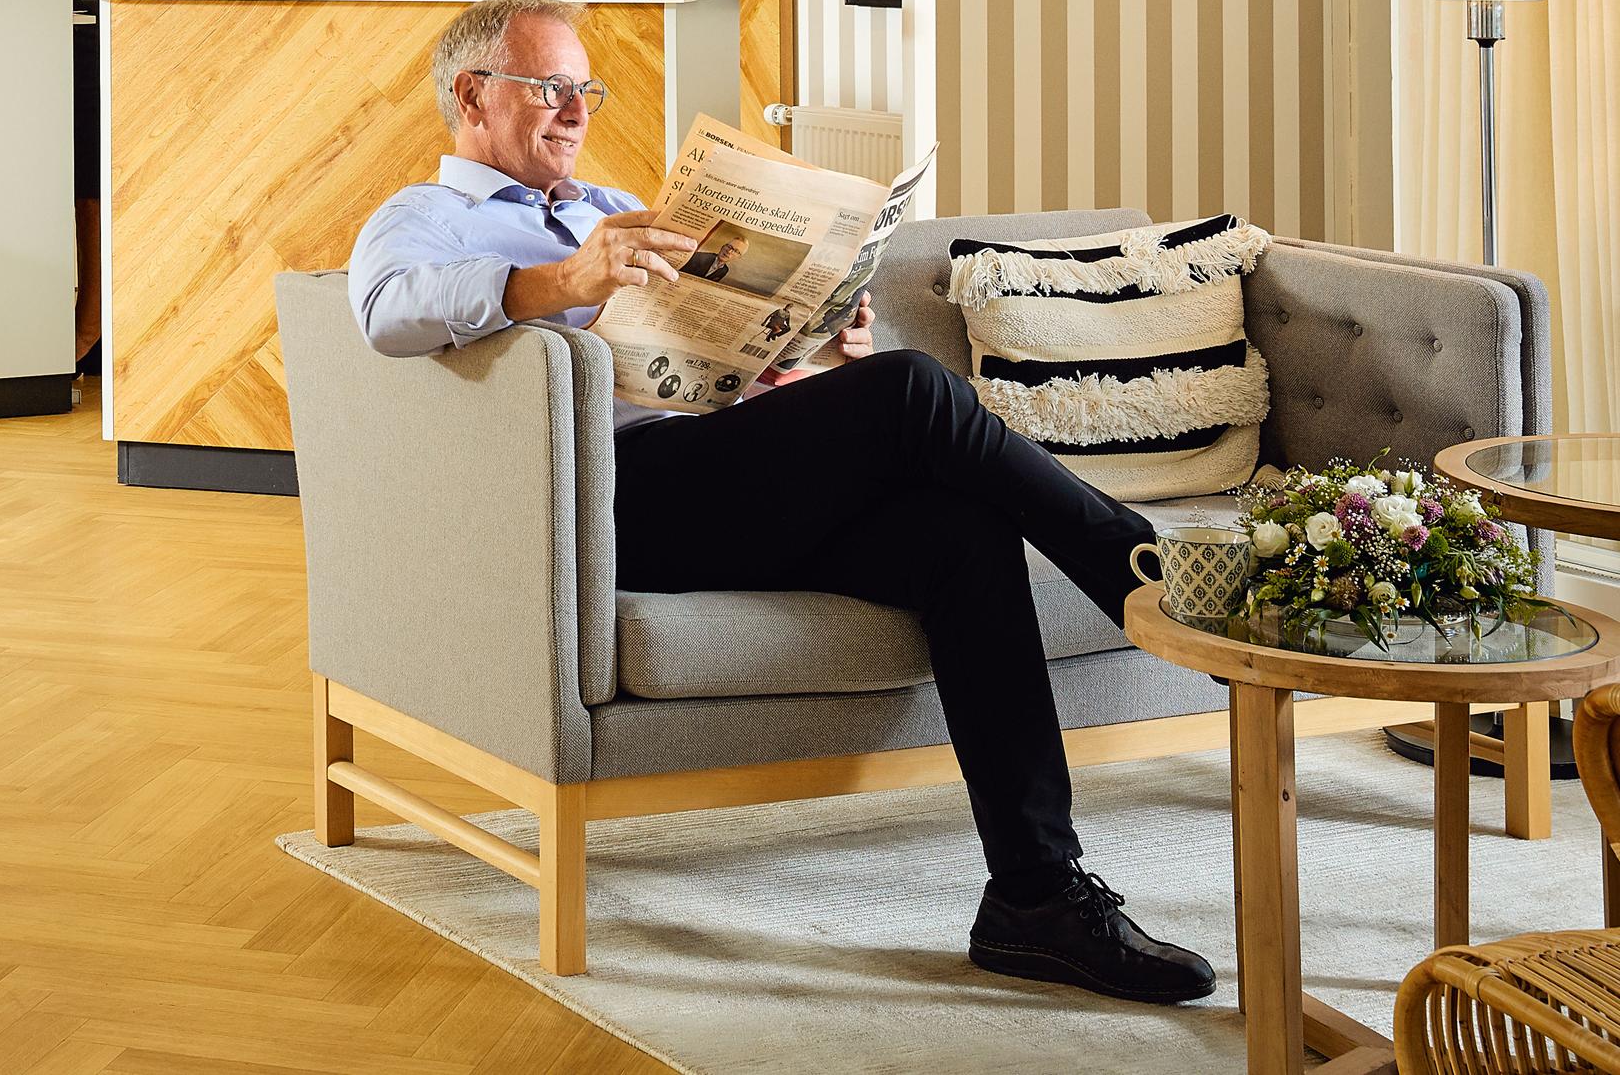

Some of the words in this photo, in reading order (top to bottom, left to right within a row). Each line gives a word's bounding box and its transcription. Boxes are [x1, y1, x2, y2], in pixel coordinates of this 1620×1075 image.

[688, 193, 712, 211] Tryg
[713, 206, 731, 216] om
[732, 210, 746, 222] til
[745, 216, 759, 226] en
[760, 220, 807, 237] speedbåd
[694, 183, 734, 204] Morten
[735, 197, 769, 214] Hübbe
[769, 207, 791, 220] skal
[791, 211, 810, 224] lave
